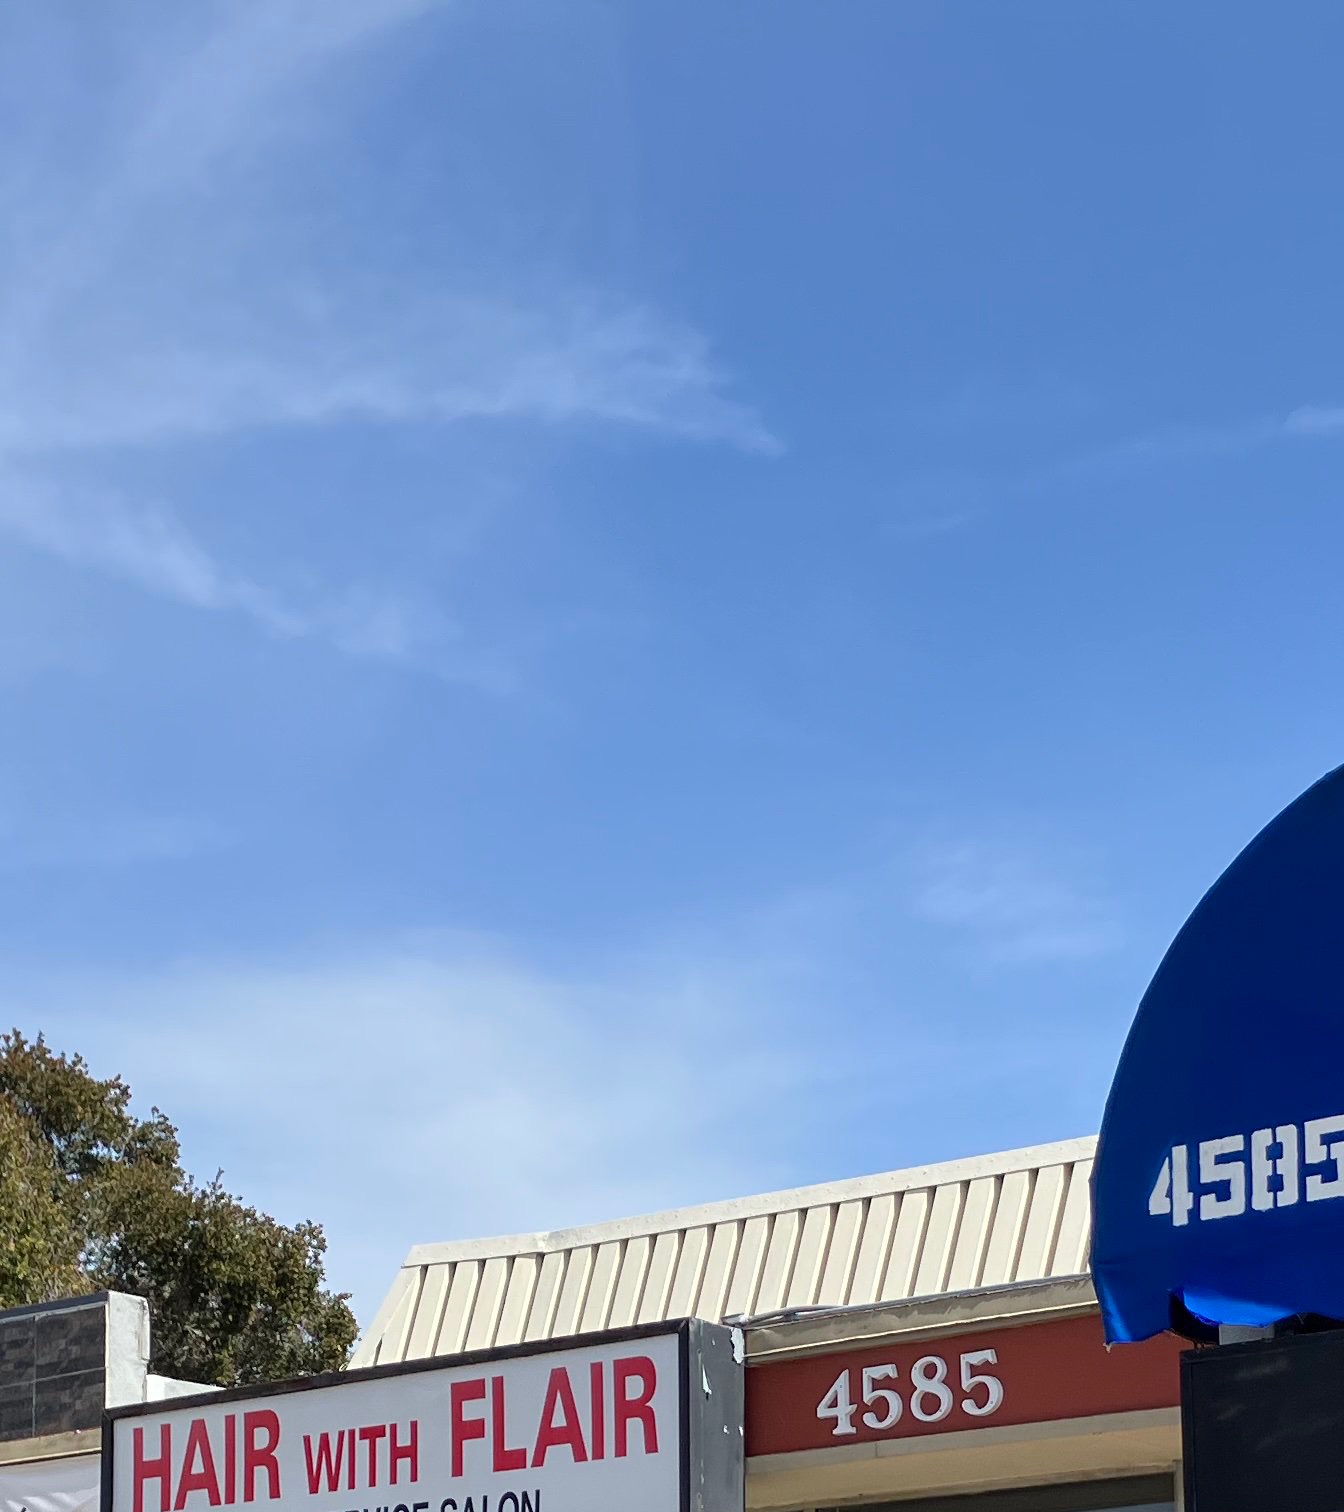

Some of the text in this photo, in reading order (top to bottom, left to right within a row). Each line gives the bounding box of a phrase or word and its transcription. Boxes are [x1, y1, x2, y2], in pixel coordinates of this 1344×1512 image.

[303, 1420, 418, 1494] WITH
[451, 1356, 659, 1477] FLAIR
[817, 1349, 1004, 1436] 4585
